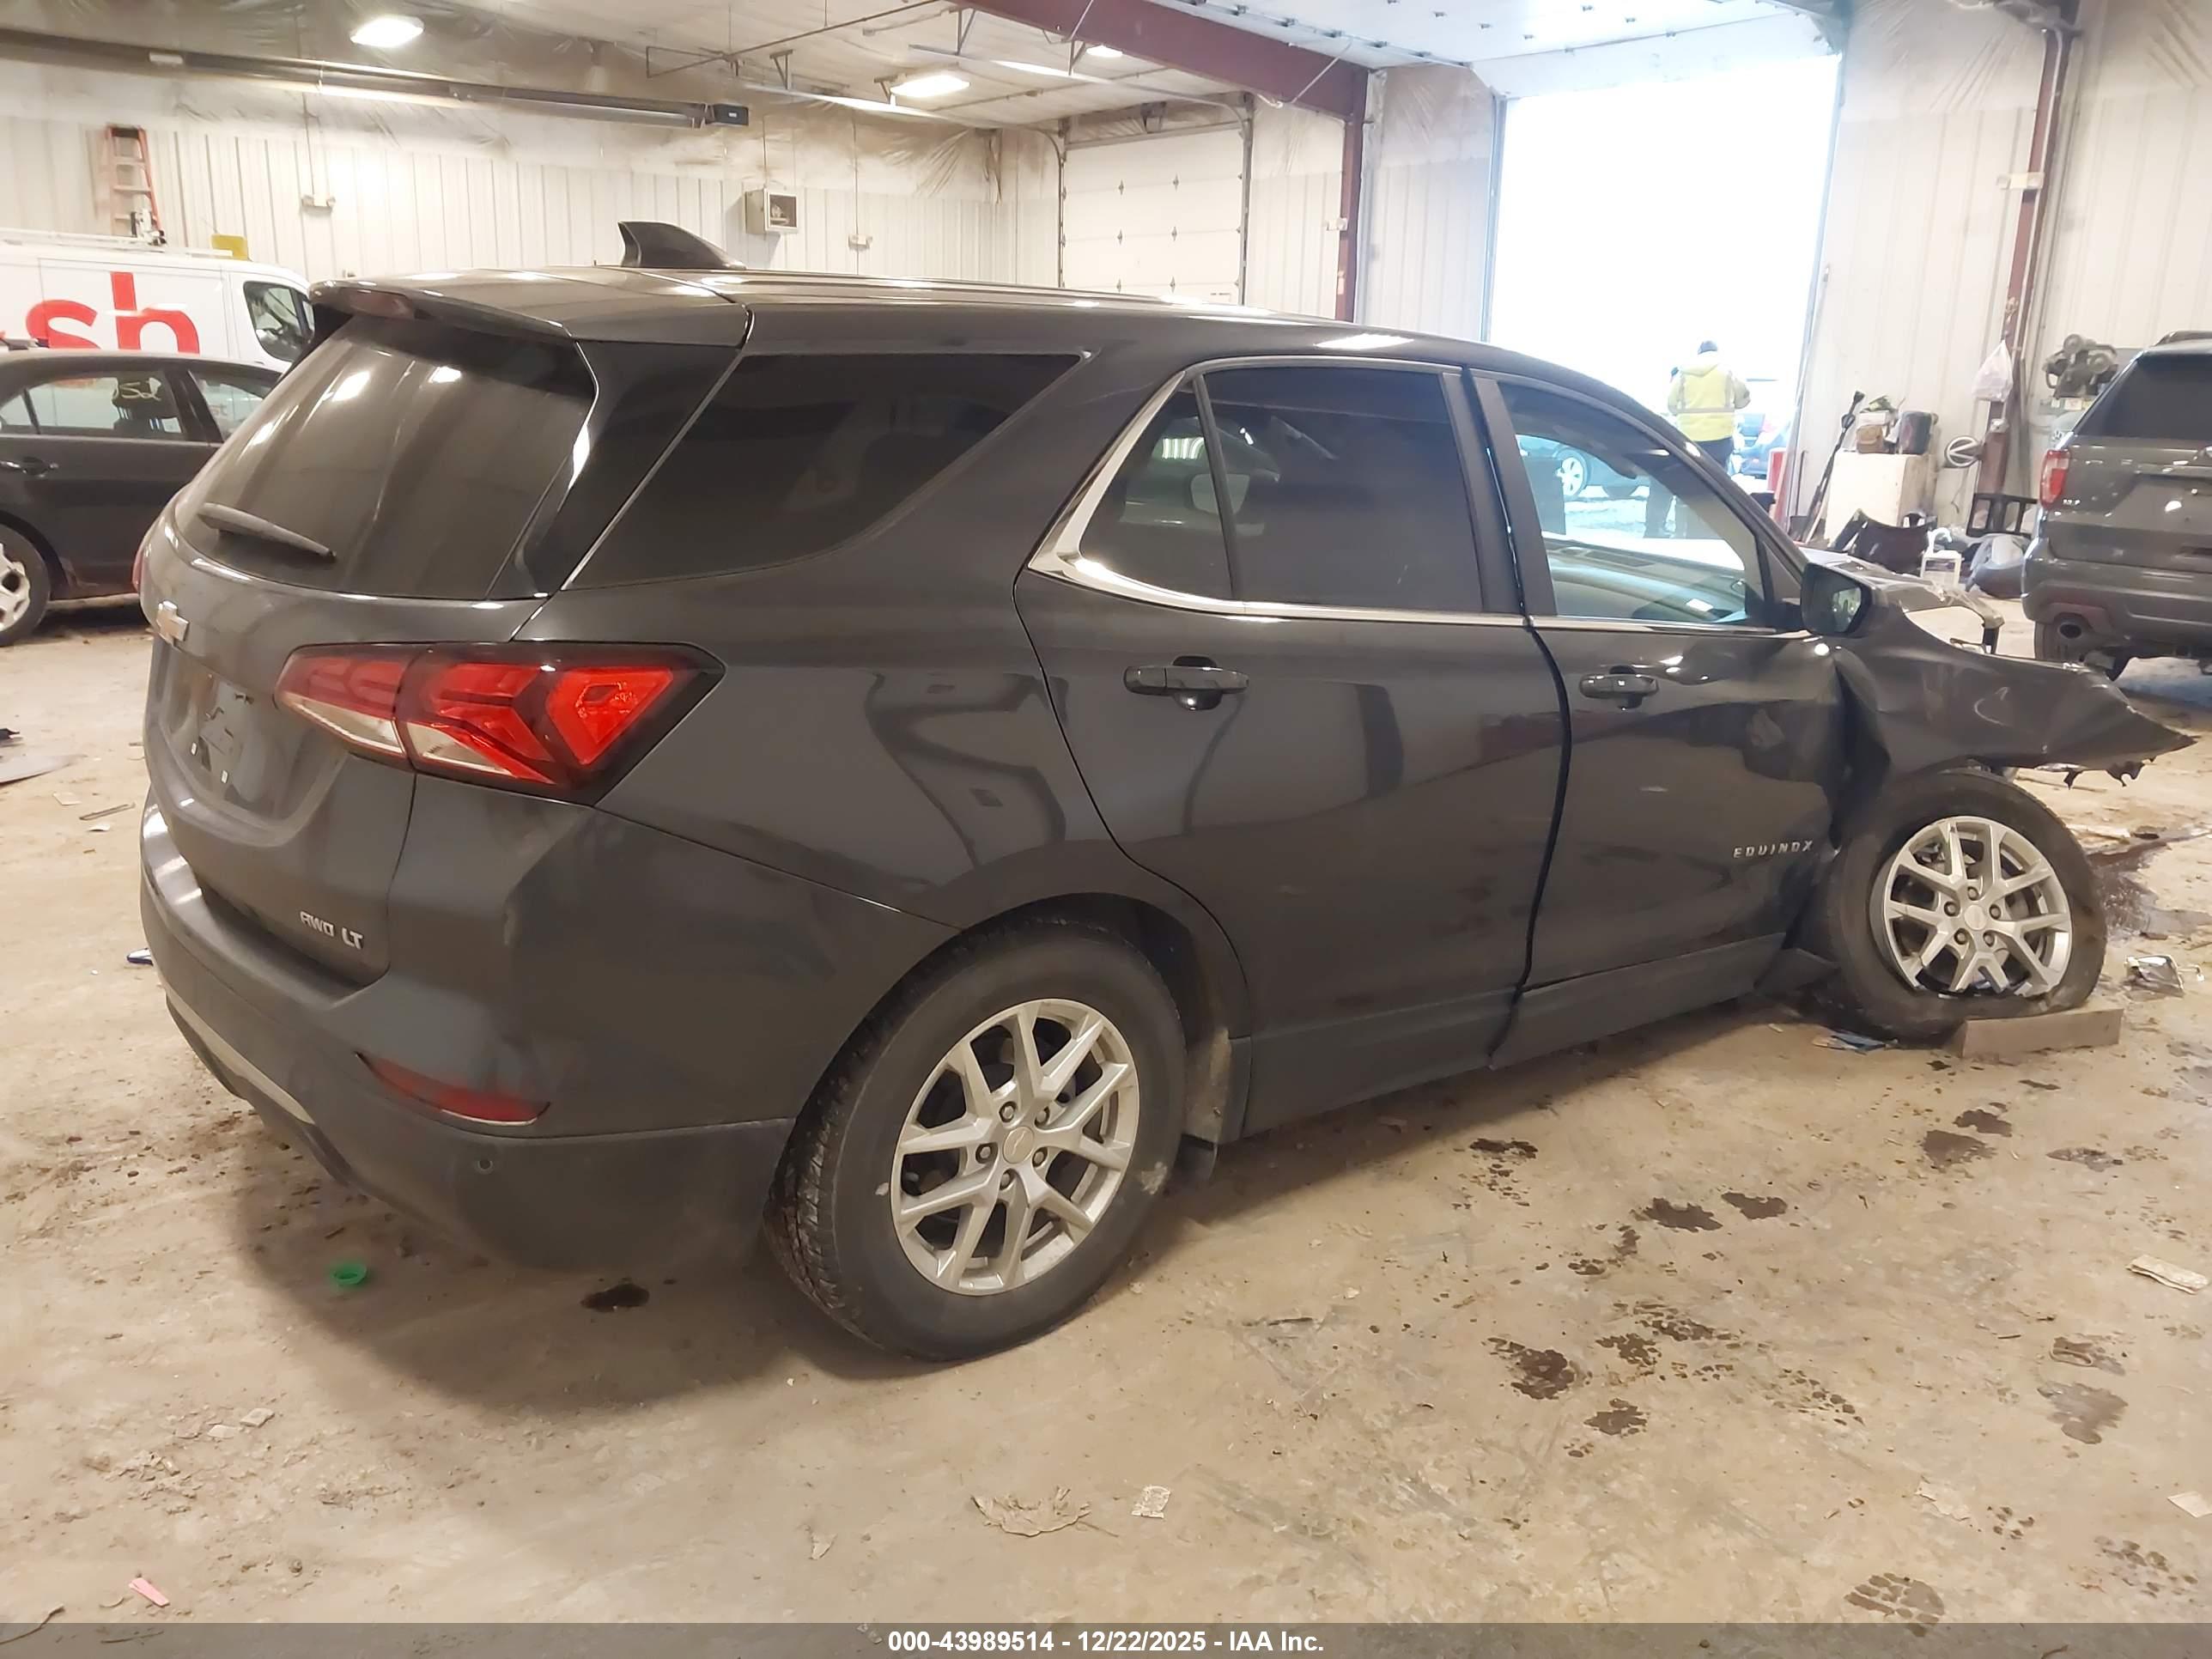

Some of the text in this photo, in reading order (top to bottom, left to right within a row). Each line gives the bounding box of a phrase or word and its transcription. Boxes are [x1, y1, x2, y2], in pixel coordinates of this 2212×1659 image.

[1733, 841, 1813, 859] EQUINOX
[299, 911, 364, 950] AWD LT
